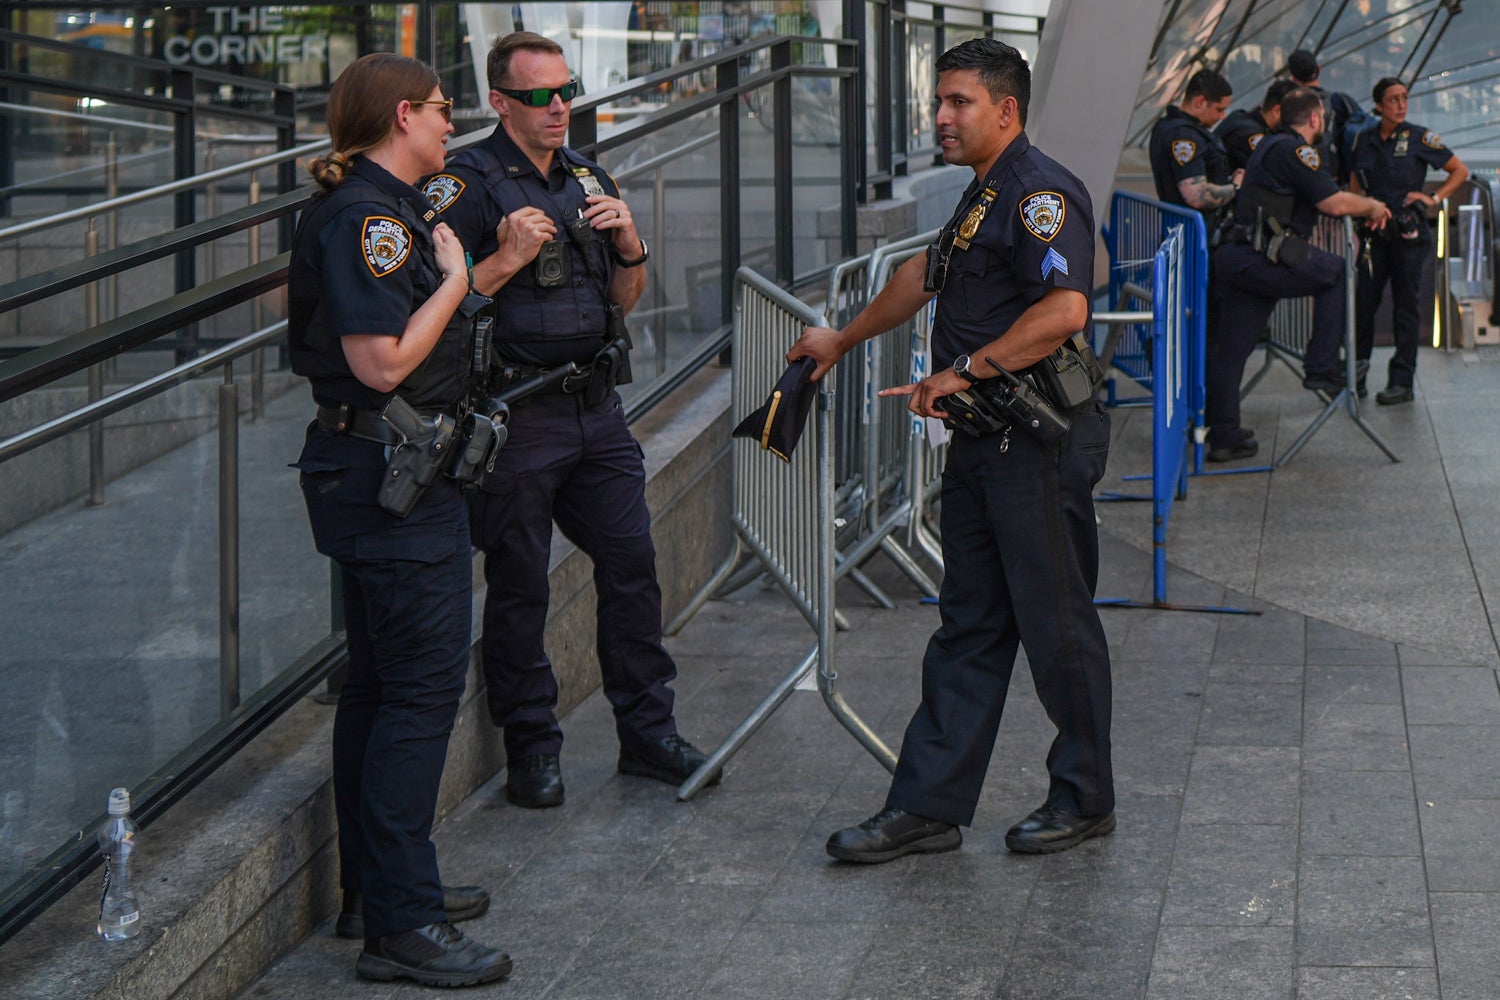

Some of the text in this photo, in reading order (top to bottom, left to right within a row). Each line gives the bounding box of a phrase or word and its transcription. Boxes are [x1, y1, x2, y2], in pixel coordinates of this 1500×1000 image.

[206, 6, 283, 33] THE
[164, 35, 329, 66] CORNER
[368, 225, 409, 245] DEPARTMENT
[379, 220, 404, 234] POLICE
